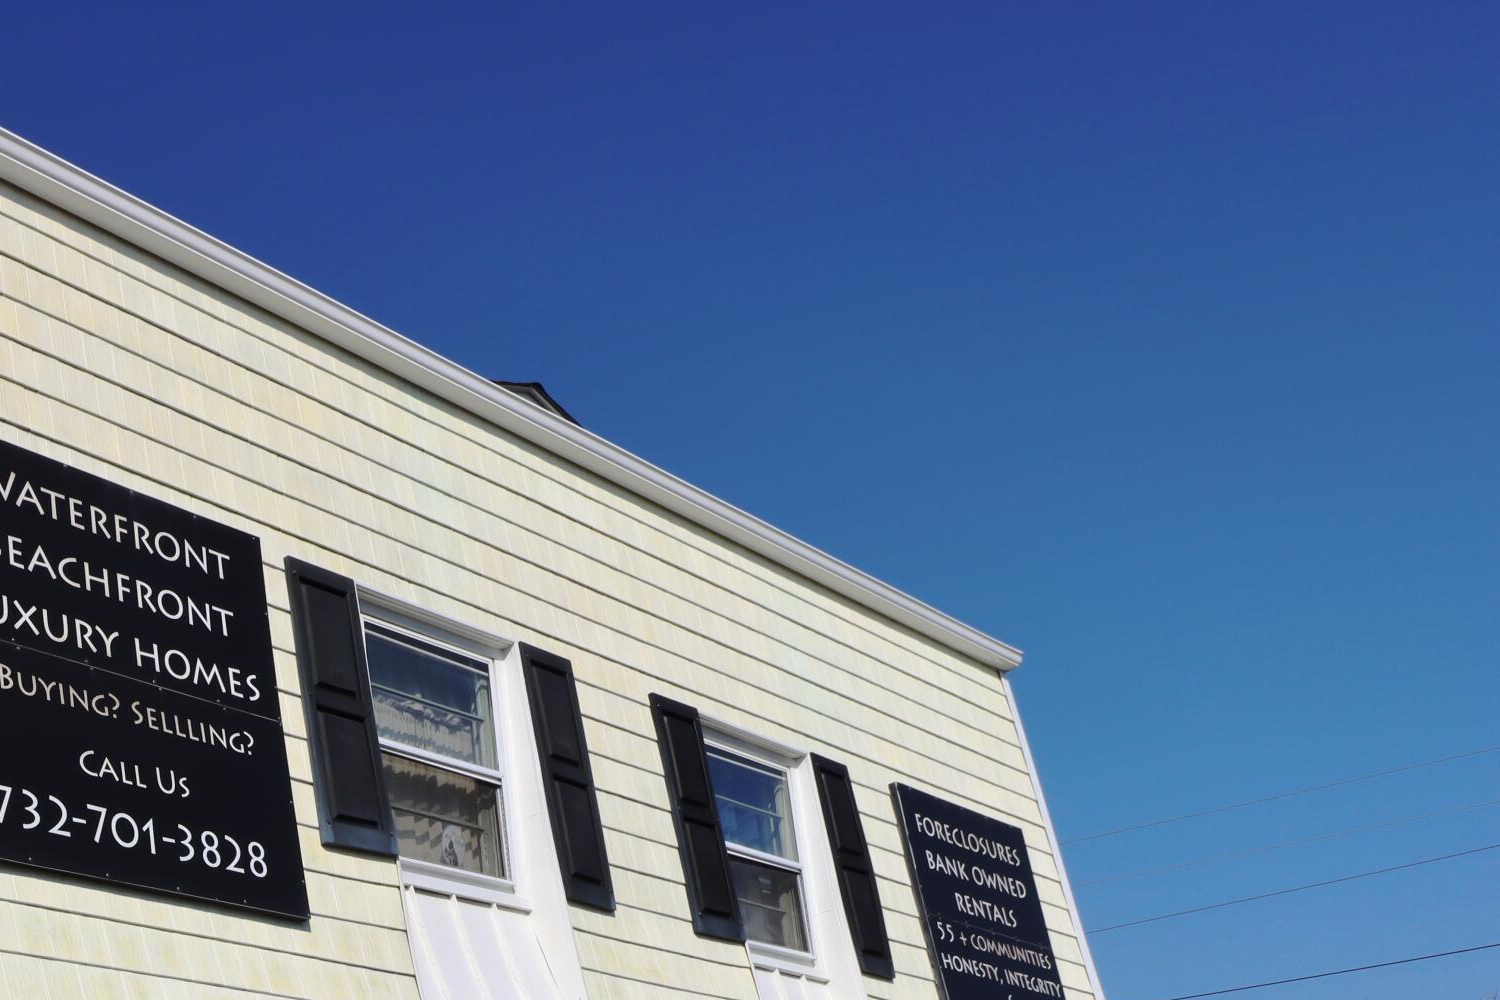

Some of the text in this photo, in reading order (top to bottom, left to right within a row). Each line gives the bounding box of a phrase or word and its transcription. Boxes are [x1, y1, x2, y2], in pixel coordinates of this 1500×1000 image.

[134, 638, 260, 701] HOMES
[131, 702, 254, 755] SELLLING?
[79, 750, 147, 789] CALL
[915, 813, 1021, 866] FORECLOSURES
[926, 850, 1026, 899] BANK OWNED
[954, 893, 1017, 928] RENTALS
[971, 934, 1051, 969] COMMUNITIES
[941, 953, 1061, 998] HONESTY, INTEGRITY
